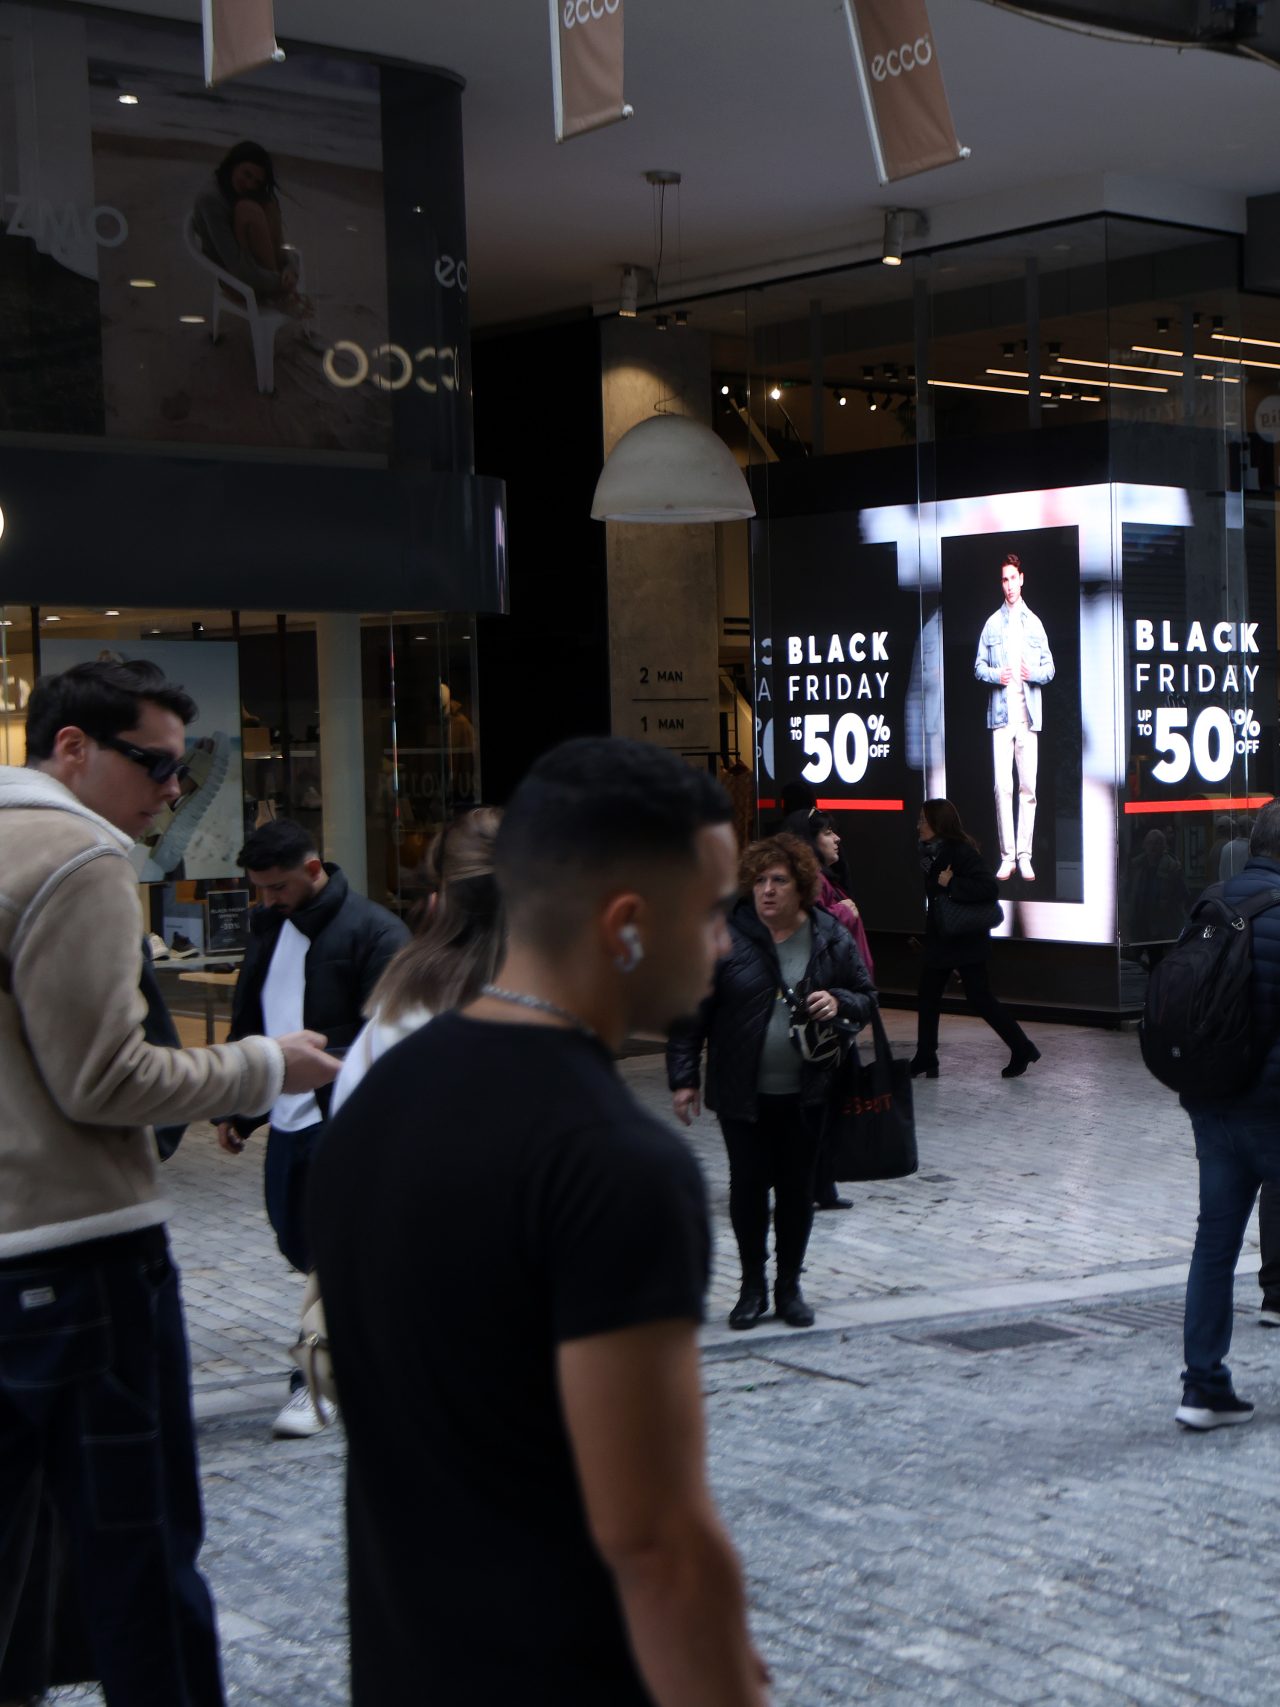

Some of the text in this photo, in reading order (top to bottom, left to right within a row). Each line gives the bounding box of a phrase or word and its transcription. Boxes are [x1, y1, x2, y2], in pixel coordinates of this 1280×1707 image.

[871, 38, 932, 81] ecco
[1135, 619, 1260, 653] BLACK
[788, 632, 889, 665] BLACK
[640, 667, 683, 684] 2 MAN
[1136, 663, 1260, 692] FRIDAY
[789, 672, 889, 701] FRIDAY
[790, 717, 801, 727] UP
[1137, 710, 1152, 721] UP
[641, 716, 684, 732] 1 MAN
[1137, 724, 1152, 736] TO
[790, 730, 802, 740] TO
[869, 744, 890, 758] OFF
[1235, 740, 1259, 754] OFF
